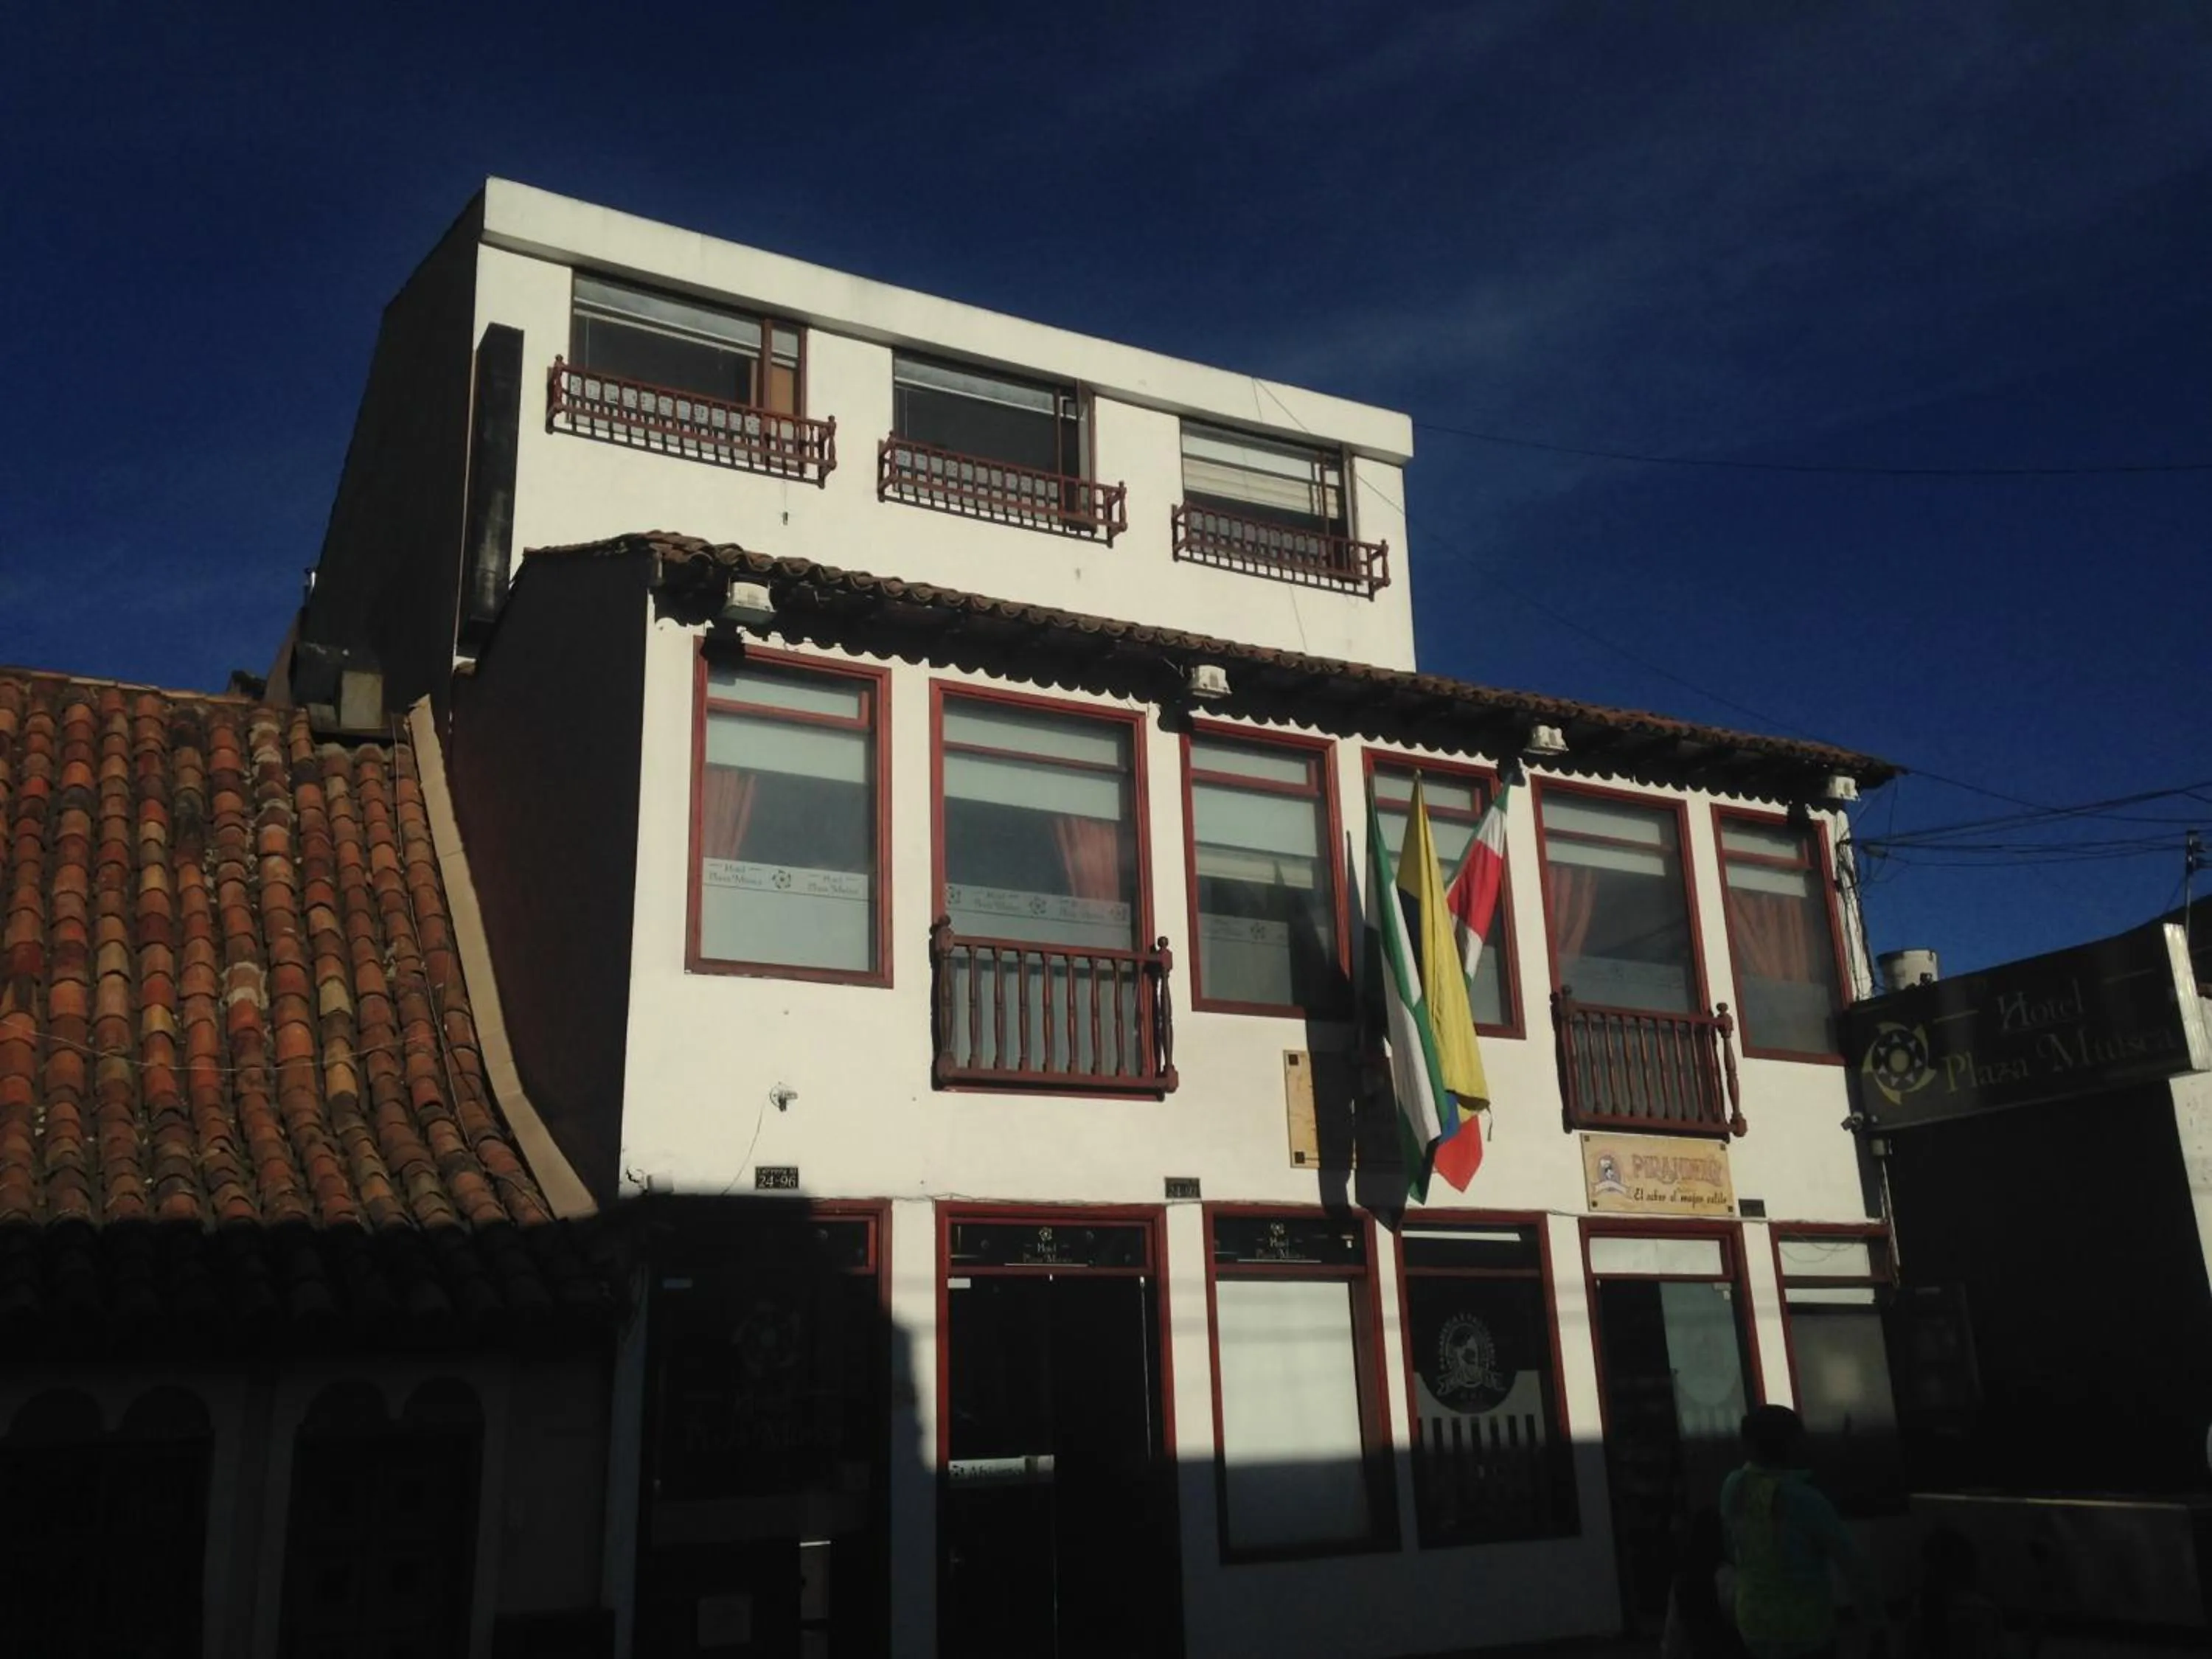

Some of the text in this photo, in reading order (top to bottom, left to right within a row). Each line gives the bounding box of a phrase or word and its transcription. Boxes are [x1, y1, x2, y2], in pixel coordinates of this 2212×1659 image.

[1997, 977, 2087, 1032] Hotel
[1944, 1025, 2177, 1094] Plaza Muisca
[758, 1175, 796, 1188] 24-96
[1633, 1187, 1644, 1201] El
